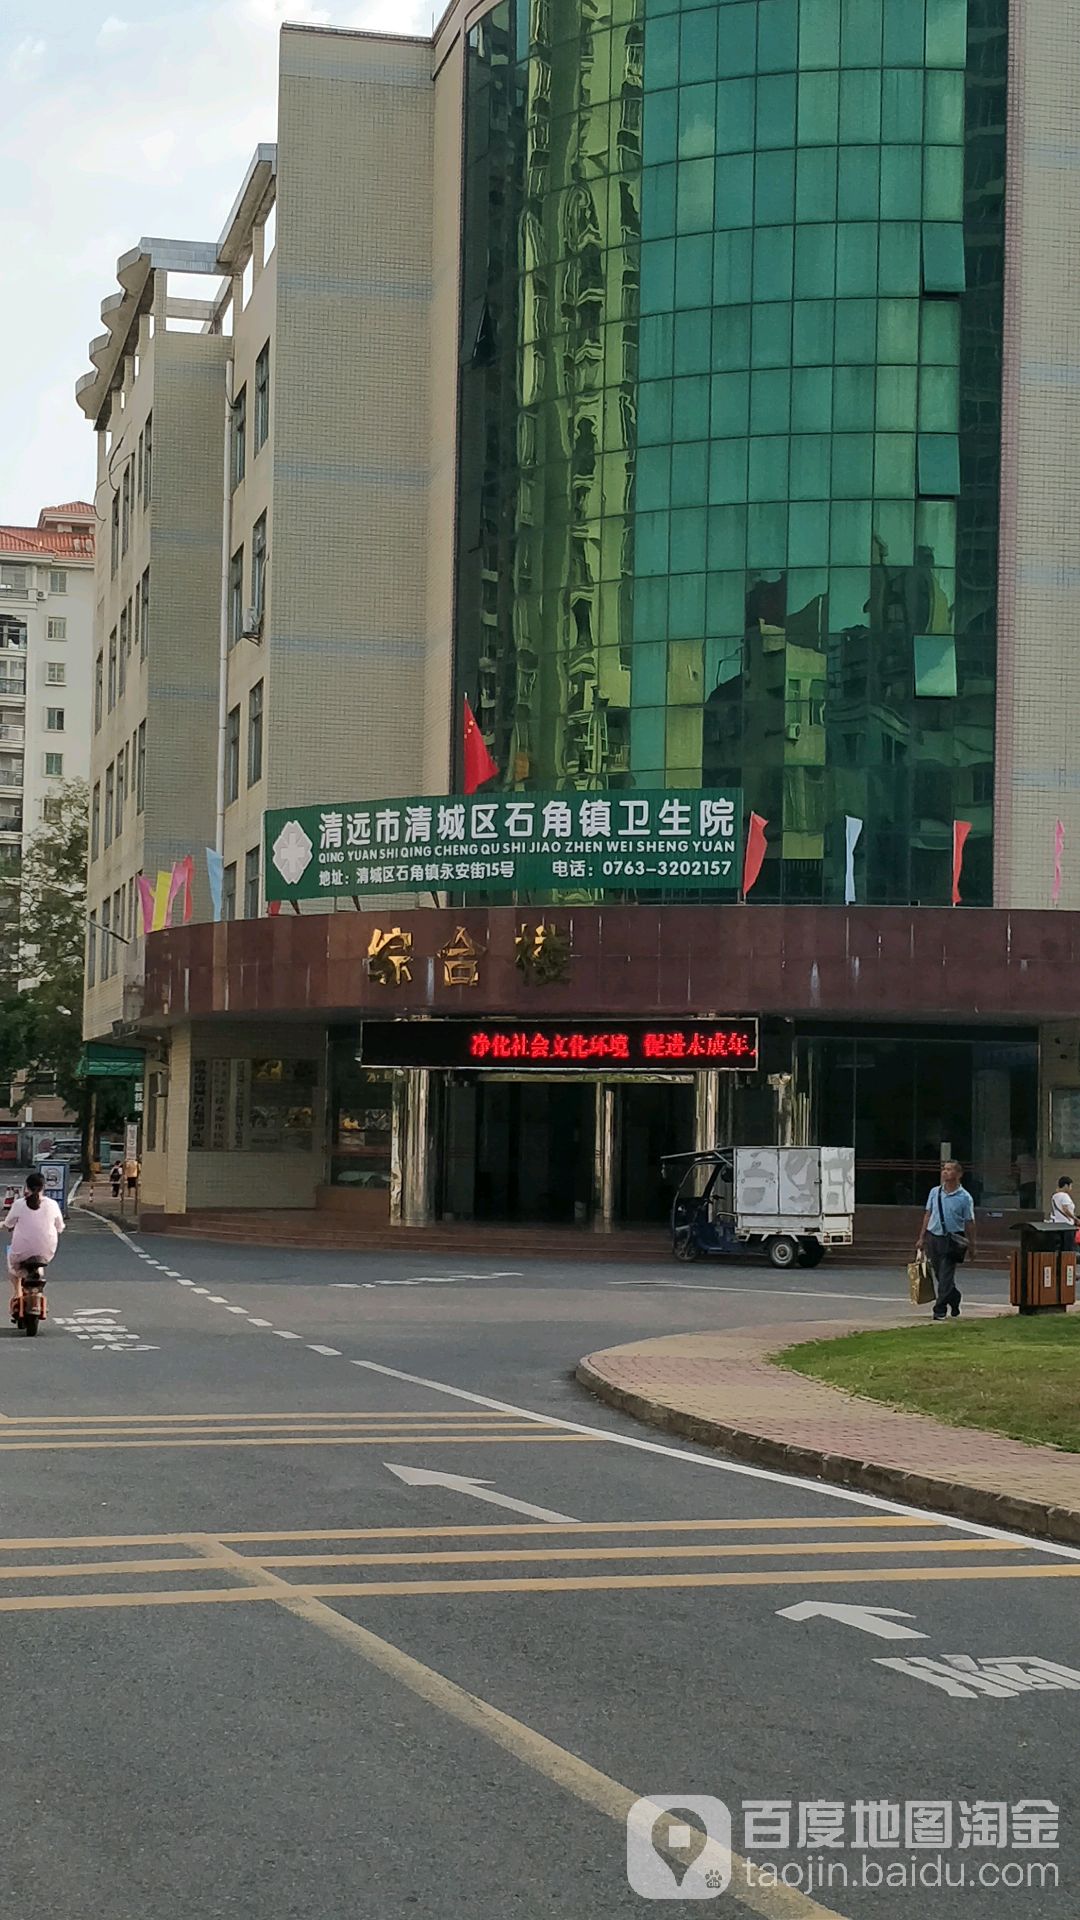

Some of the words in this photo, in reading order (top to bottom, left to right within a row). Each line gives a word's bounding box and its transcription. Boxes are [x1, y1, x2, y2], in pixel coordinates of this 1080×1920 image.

[318, 797, 735, 849] 清远市清城区石角镇卫生院
[318, 851, 345, 864] QING
[348, 849, 377, 862] YUAN
[379, 847, 399, 860] SHI
[401, 845, 432, 858] QING
[434, 844, 478, 857] CHENG
[480, 842, 500, 855] QU
[502, 842, 526, 854] SHI
[529, 841, 562, 853] JIAO
[565, 841, 603, 853] ZHEN
[606, 840, 633, 853] WEI
[636, 840, 689, 852] SHENG
[692, 840, 735, 852] YUAN
[471, 1032, 630, 1058] 净化社会文化环境
